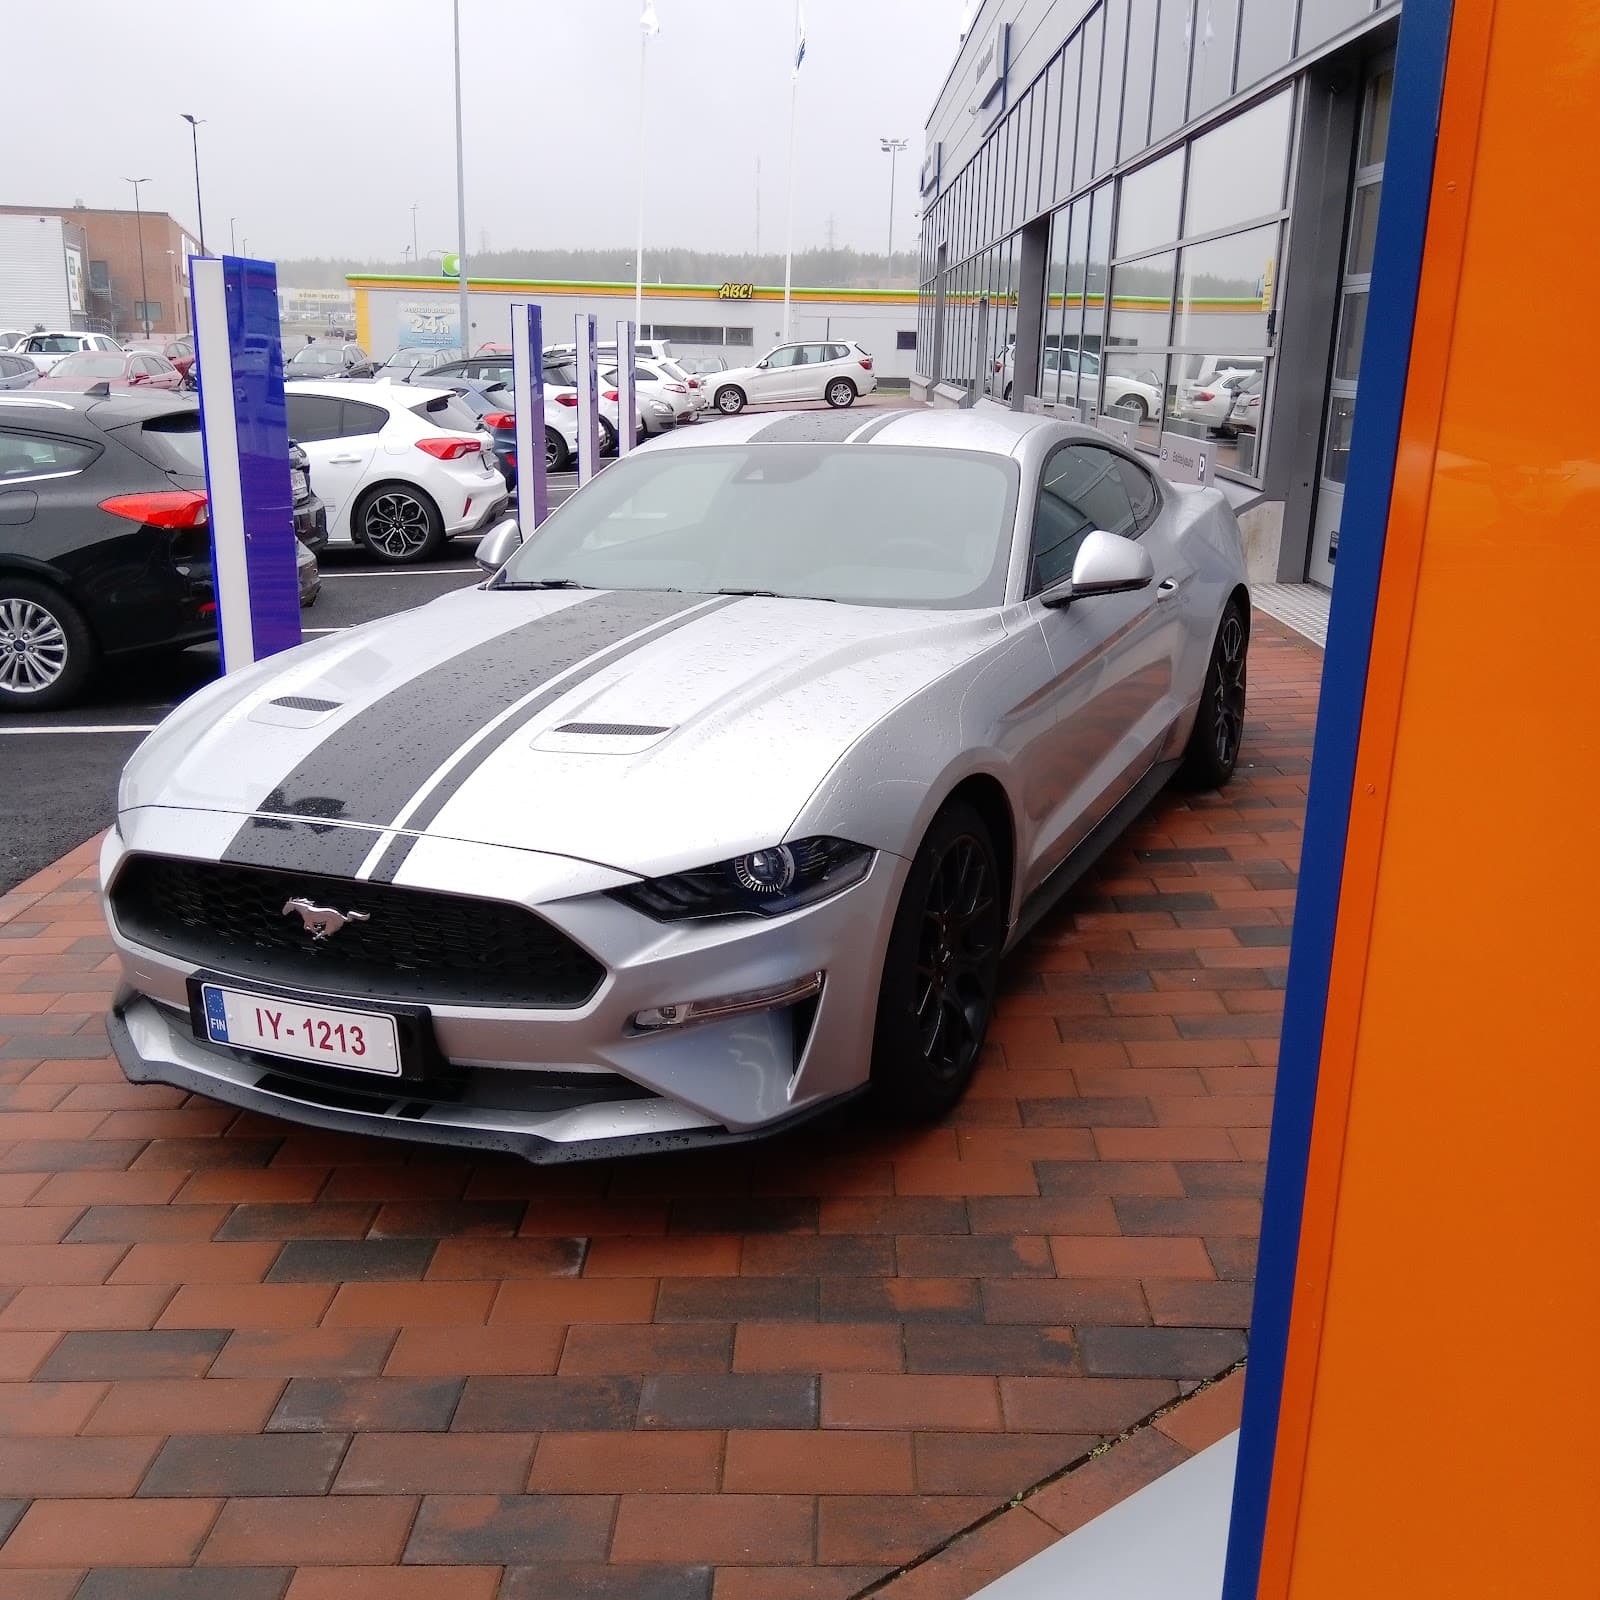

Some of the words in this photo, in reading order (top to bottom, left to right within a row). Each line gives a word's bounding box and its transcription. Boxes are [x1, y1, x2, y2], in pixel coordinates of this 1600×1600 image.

[719, 282, 754, 299] ABC!
[410, 317, 449, 334] 24h
[210, 1017, 227, 1032] FIN
[255, 1007, 367, 1056] IY-1213
